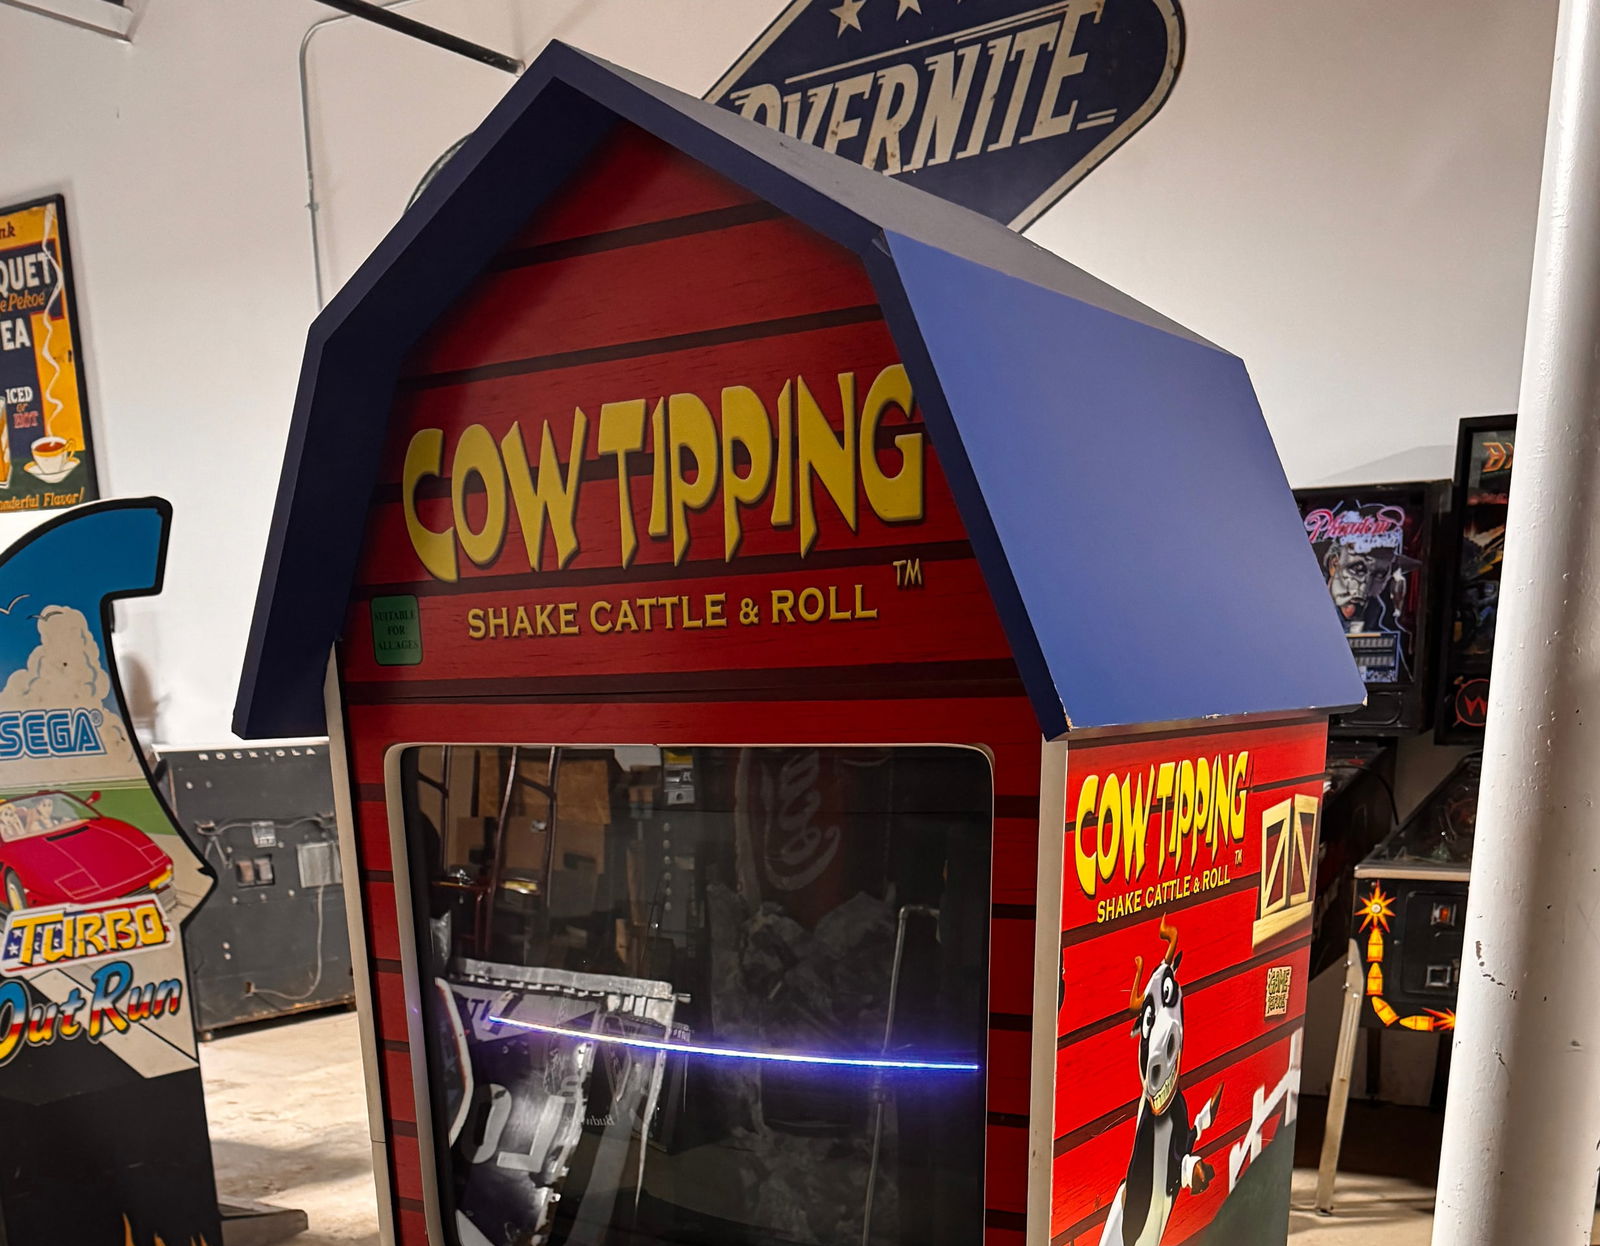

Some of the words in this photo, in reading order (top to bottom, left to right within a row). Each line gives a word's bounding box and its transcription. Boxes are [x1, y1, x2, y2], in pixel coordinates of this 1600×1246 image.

[5, 386, 33, 404] ICED
[13, 410, 39, 429] HOT
[43, 486, 85, 507] Flavor!
[403, 406, 589, 584] COW
[598, 363, 924, 570] TIPPING
[892, 559, 923, 586] TM
[468, 601, 580, 639] SHAKE
[590, 593, 728, 632] CATTLE
[740, 598, 760, 625] &
[771, 584, 878, 624] ROLL
[0, 708, 104, 759] SEGA
[1075, 763, 1156, 897] COW
[1156, 750, 1250, 877] TIPPING
[1097, 889, 1142, 924] SHAKE
[1145, 875, 1191, 909] CATTLE
[1193, 877, 1200, 893] &
[1202, 864, 1231, 892] ROLL
[11, 903, 167, 967] TURBO
